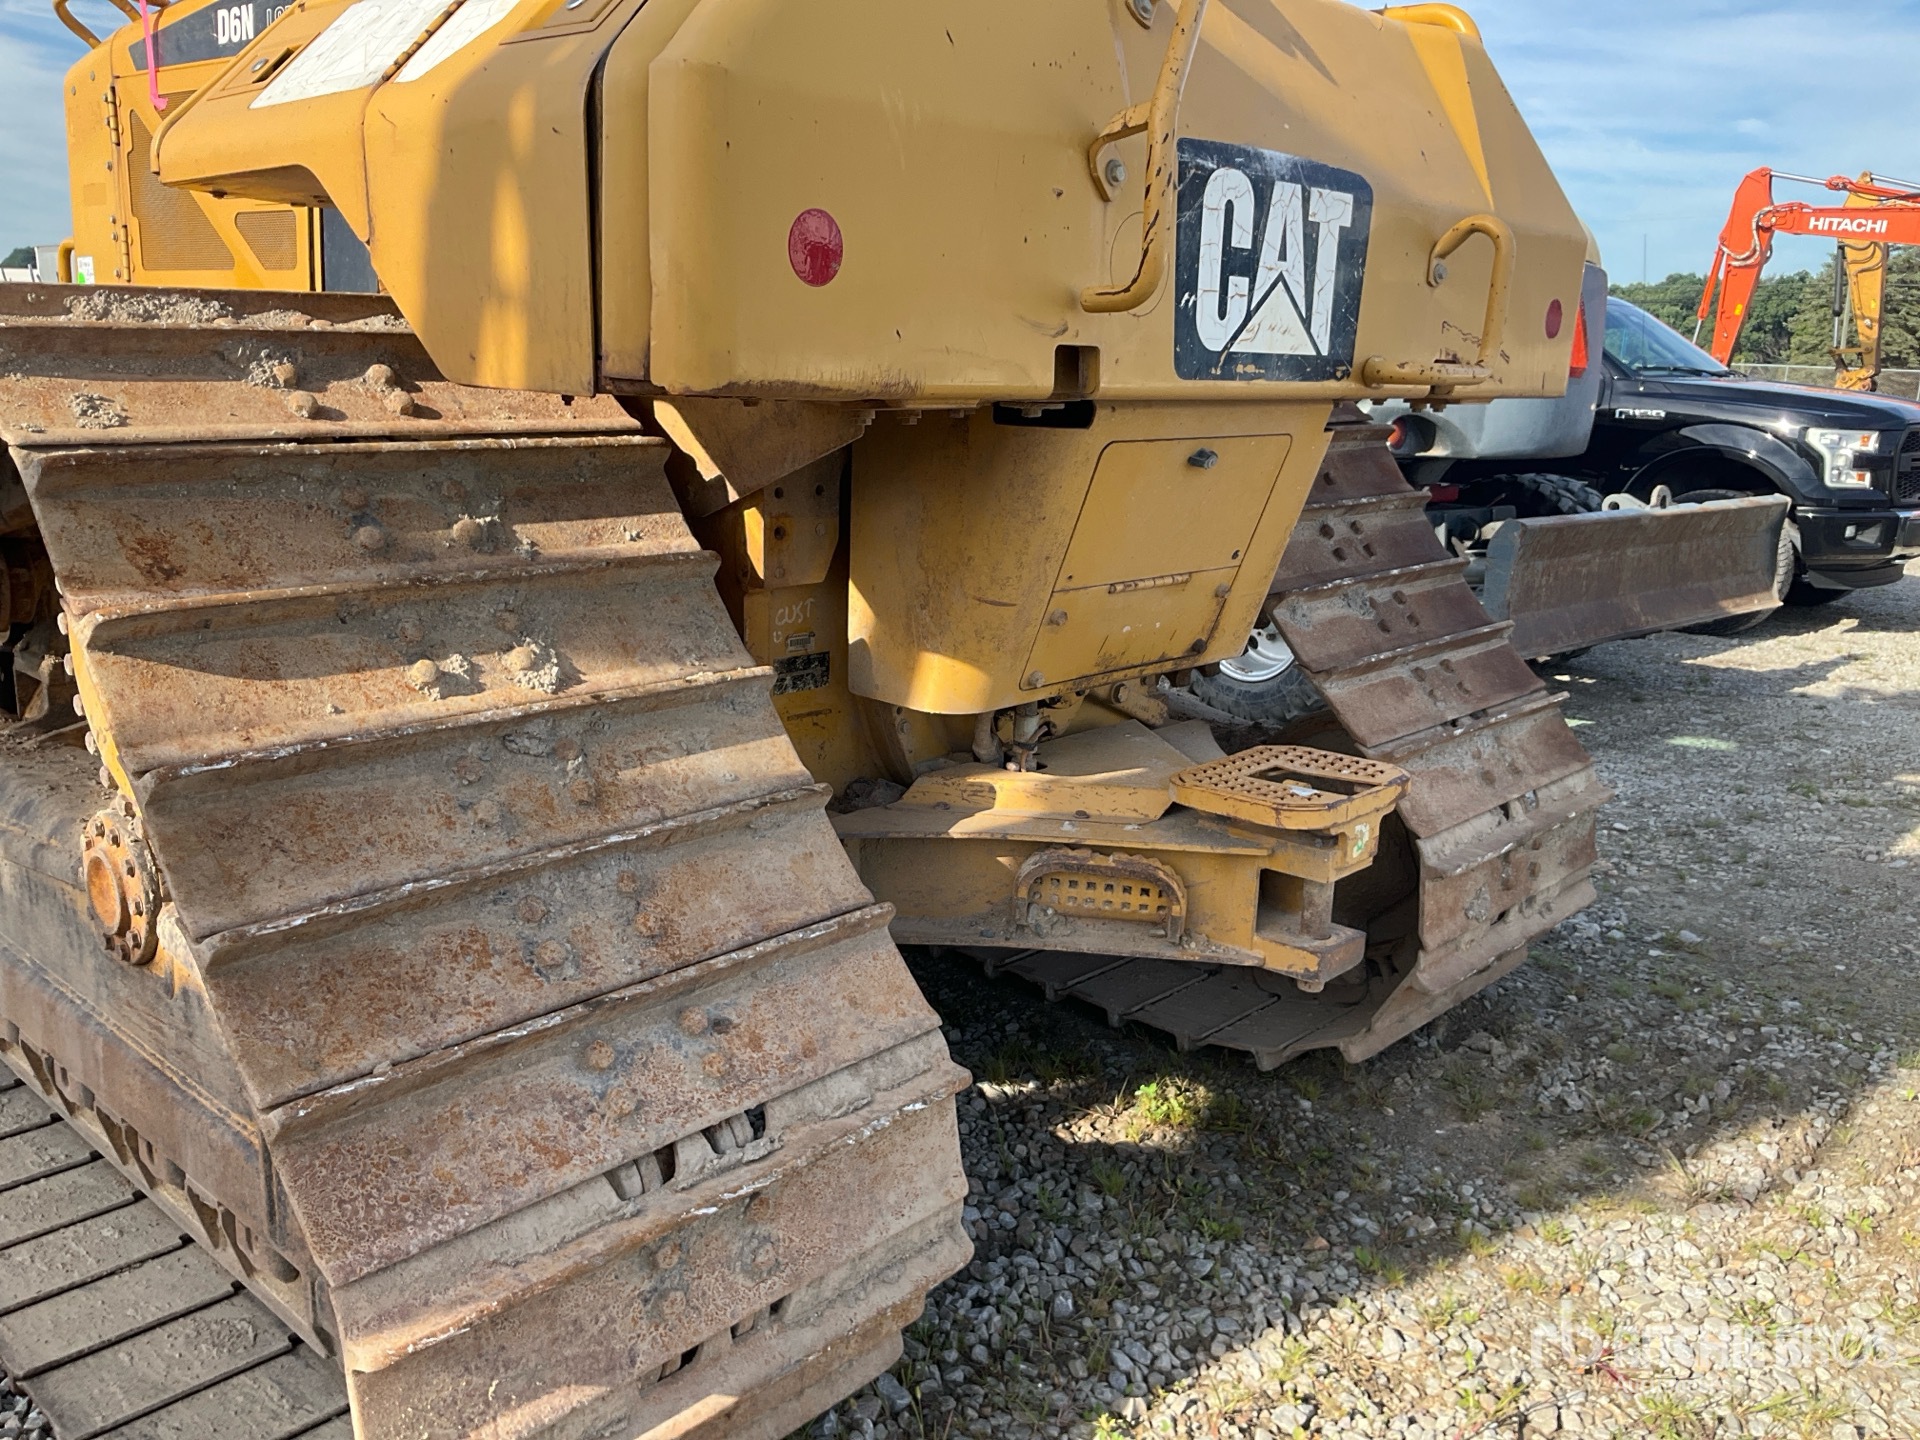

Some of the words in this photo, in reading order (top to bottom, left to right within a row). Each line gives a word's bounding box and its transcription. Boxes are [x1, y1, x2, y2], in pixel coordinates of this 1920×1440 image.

[217, 3, 254, 45] D6N
[1808, 216, 1889, 234] HITACHI
[1196, 167, 1353, 356] CAT
